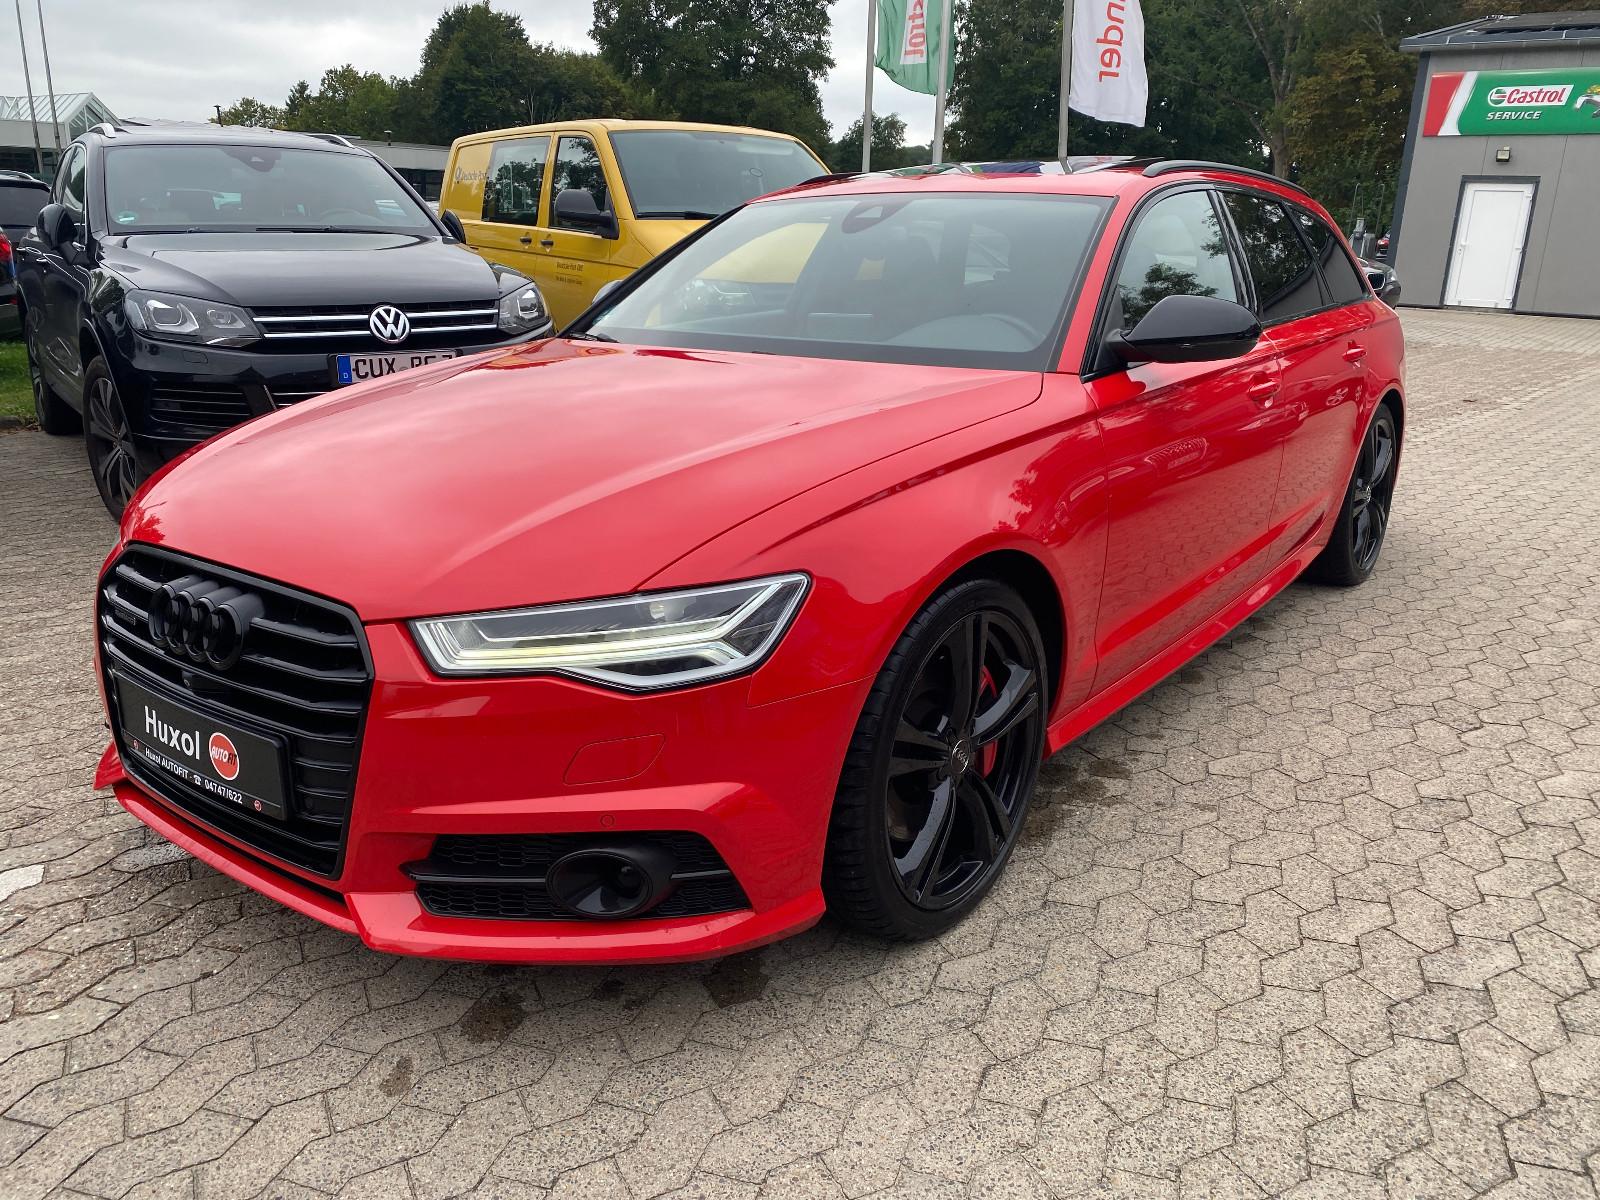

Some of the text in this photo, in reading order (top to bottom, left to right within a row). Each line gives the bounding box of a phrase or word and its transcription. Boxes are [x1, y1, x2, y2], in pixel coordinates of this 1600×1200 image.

[1507, 88, 1566, 104] Castrol
[1486, 111, 1542, 120] SERVICE
[354, 357, 396, 379] CUX
[144, 705, 200, 760] Huxol
[145, 747, 161, 764] Huxol
[161, 758, 189, 779] AUTOFIT
[211, 746, 237, 766] AUTOFIT
